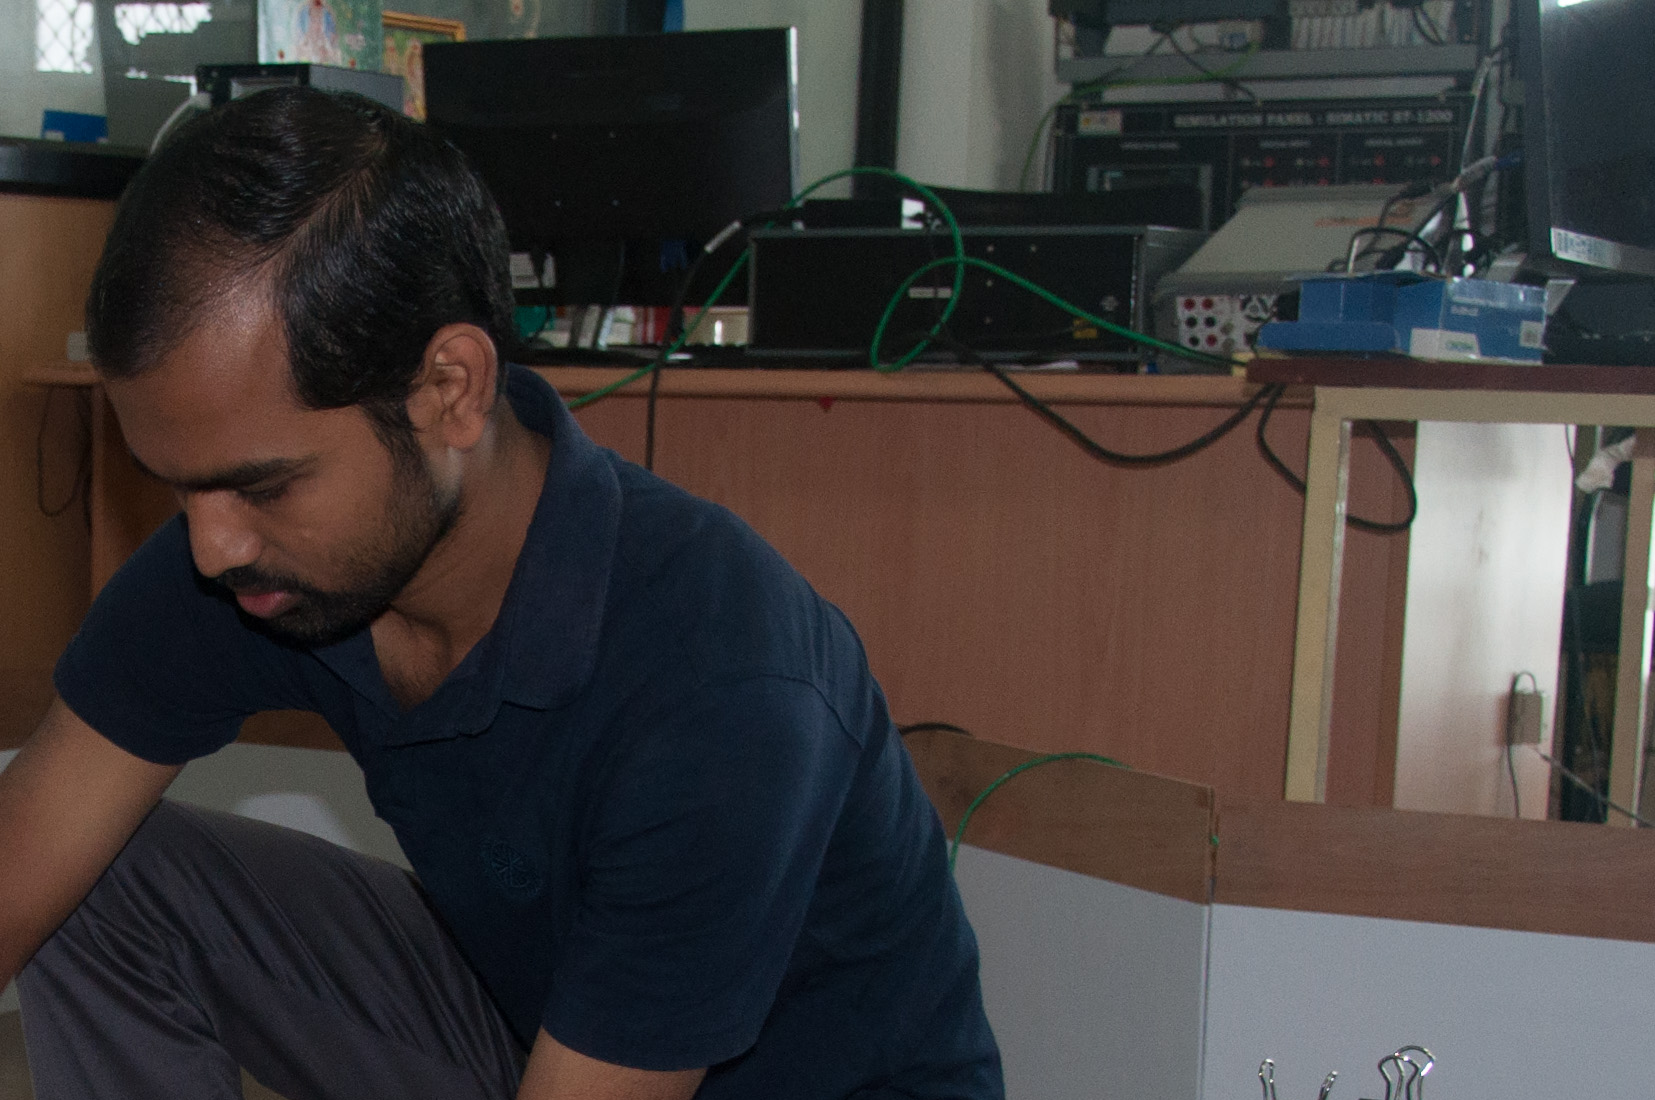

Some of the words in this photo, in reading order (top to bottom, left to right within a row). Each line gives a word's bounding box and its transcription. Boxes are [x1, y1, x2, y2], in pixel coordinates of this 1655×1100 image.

[1174, 113, 1263, 128] SIMULATION
[1266, 112, 1313, 126] PANEL
[1326, 111, 1388, 125] SIMATIC
